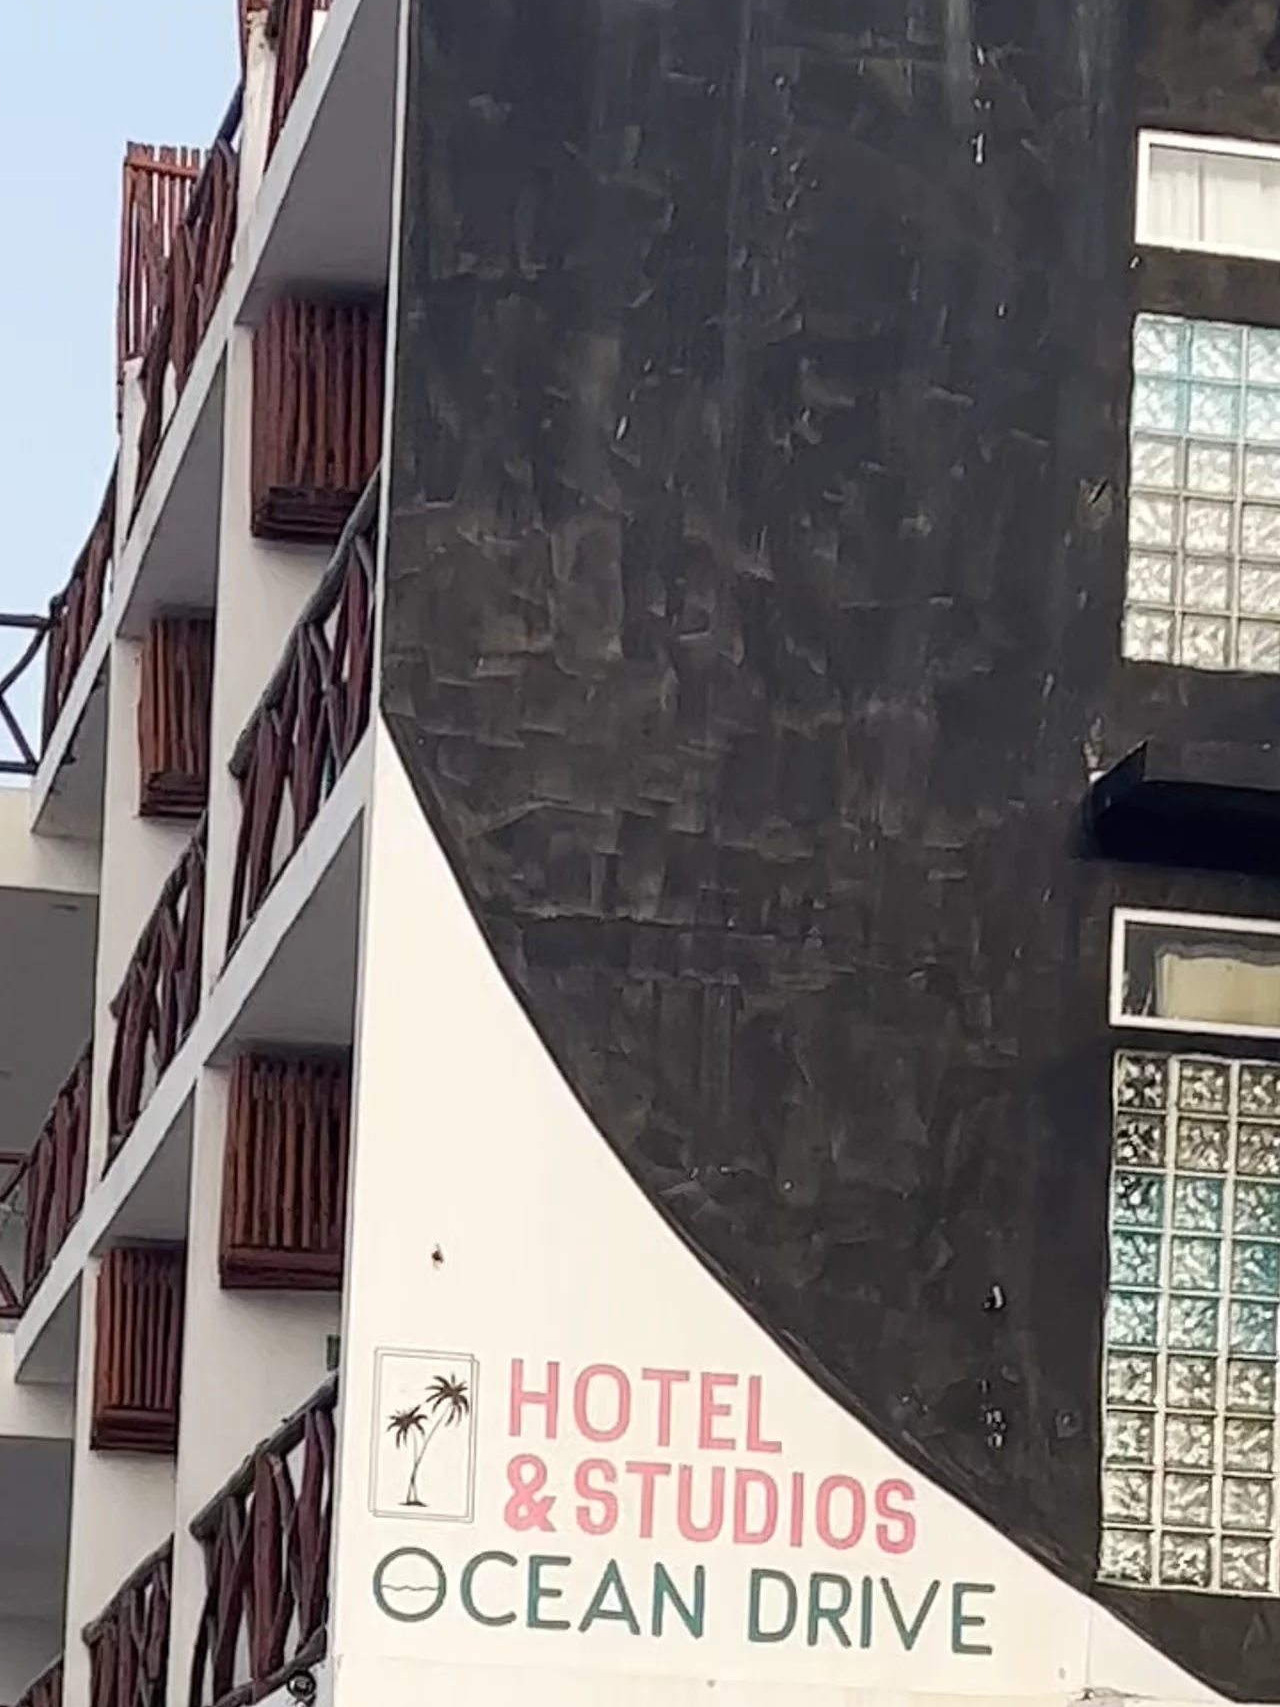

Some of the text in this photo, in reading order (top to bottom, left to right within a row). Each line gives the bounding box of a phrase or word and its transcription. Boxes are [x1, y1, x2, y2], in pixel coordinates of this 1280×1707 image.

[506, 1358, 783, 1455] HOTEL
[371, 1545, 998, 1656] OCEAN DRIVE
